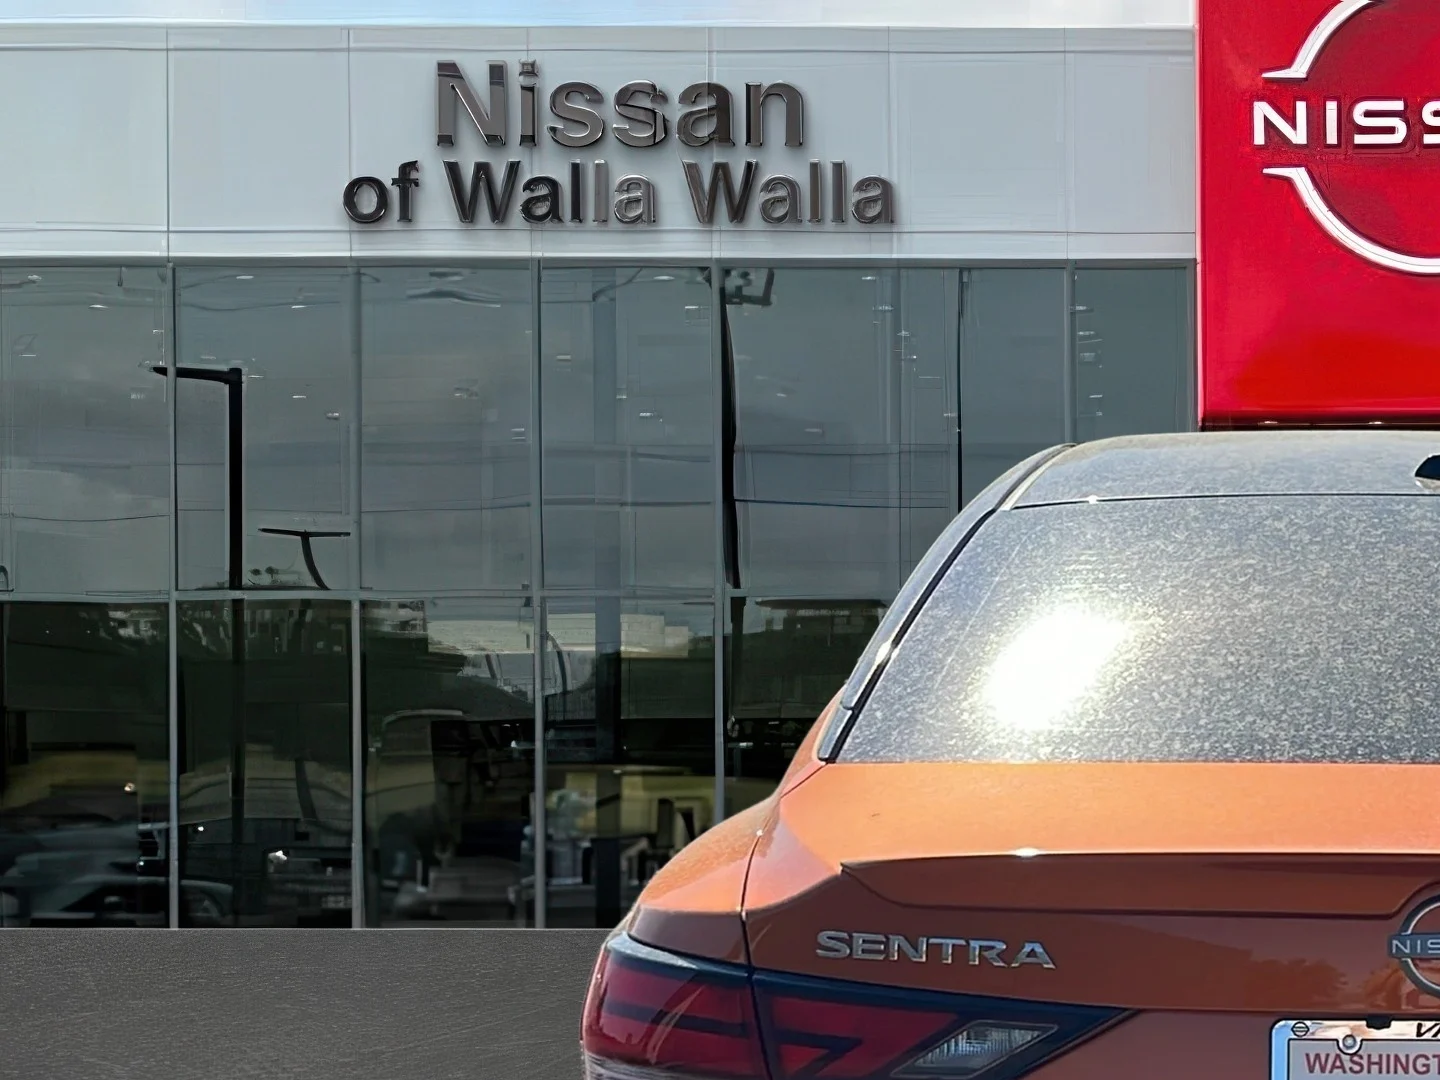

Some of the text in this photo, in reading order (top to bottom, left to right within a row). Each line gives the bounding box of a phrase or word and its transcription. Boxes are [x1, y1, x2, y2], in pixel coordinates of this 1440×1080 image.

[436, 60, 804, 147] Nissan
[342, 160, 896, 224] of Walla Walla
[816, 931, 1056, 969] SENTRA
